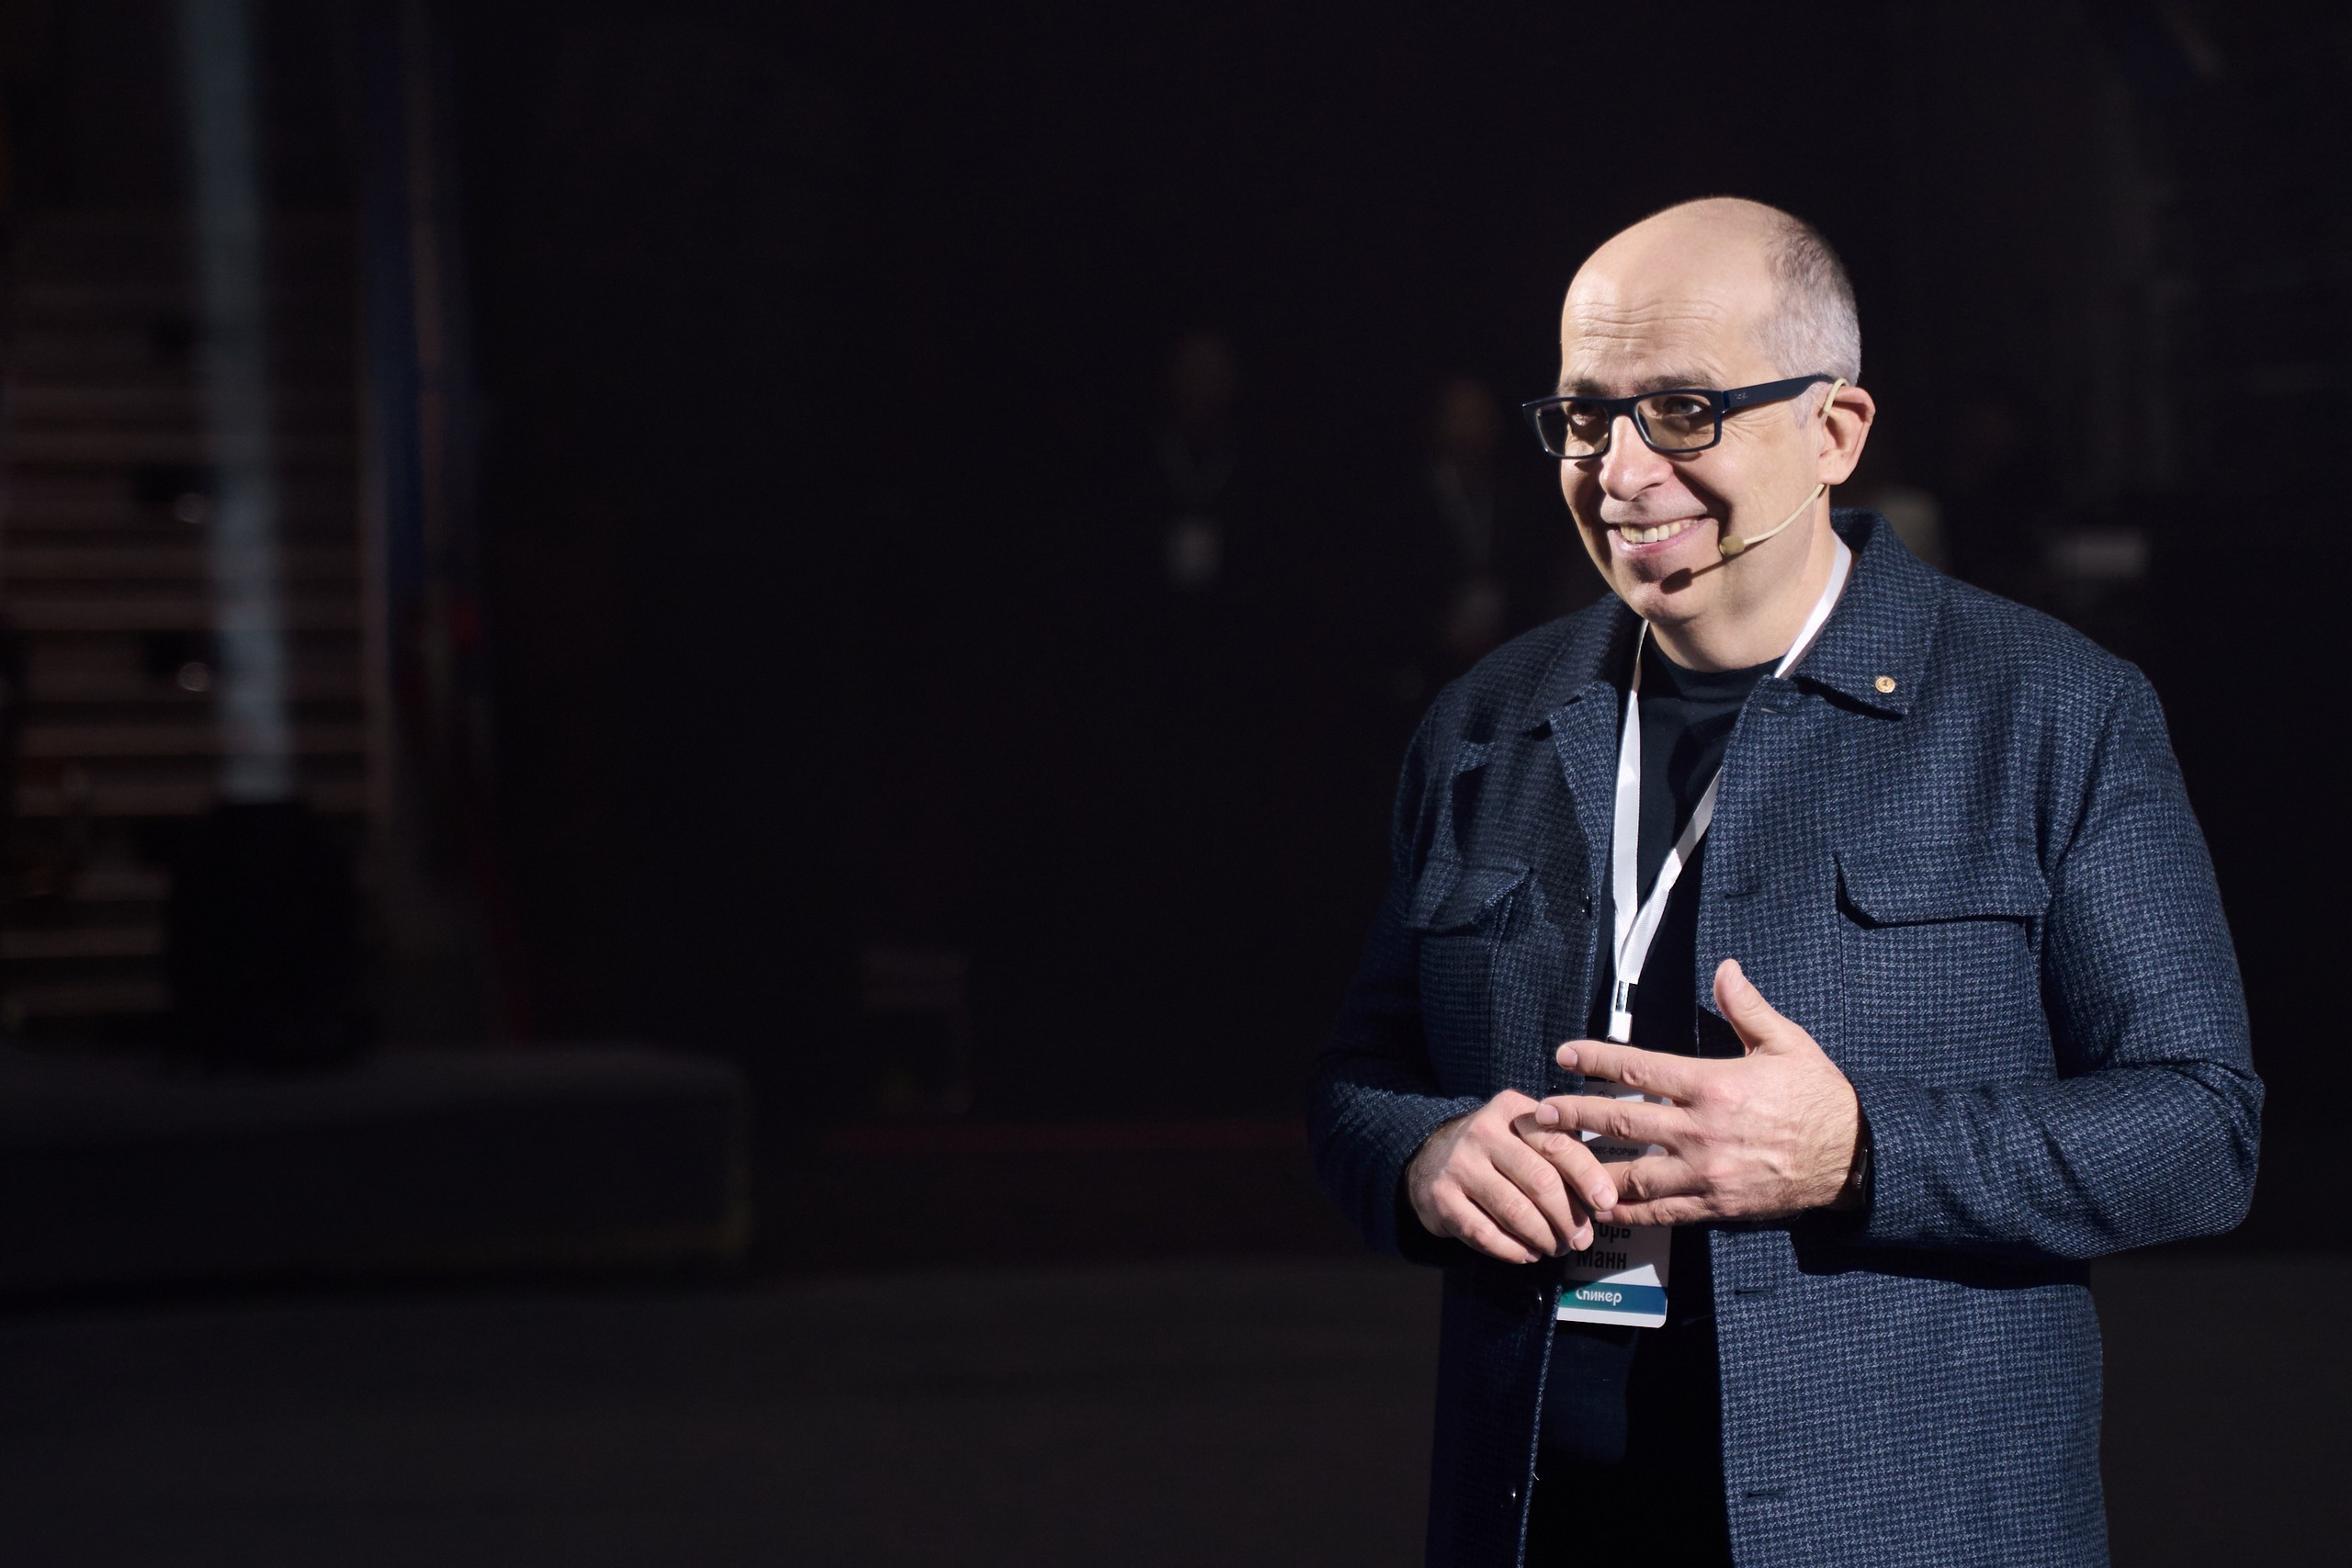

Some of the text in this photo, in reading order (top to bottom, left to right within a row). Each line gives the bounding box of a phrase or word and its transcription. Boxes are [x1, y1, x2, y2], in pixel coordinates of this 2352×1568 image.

[1589, 1145, 1639, 1156] НЕС-ФОРУМ
[1594, 1222, 1631, 1243] орь
[1577, 1247, 1627, 1269] Манн
[1576, 1287, 1623, 1306] Спикер
